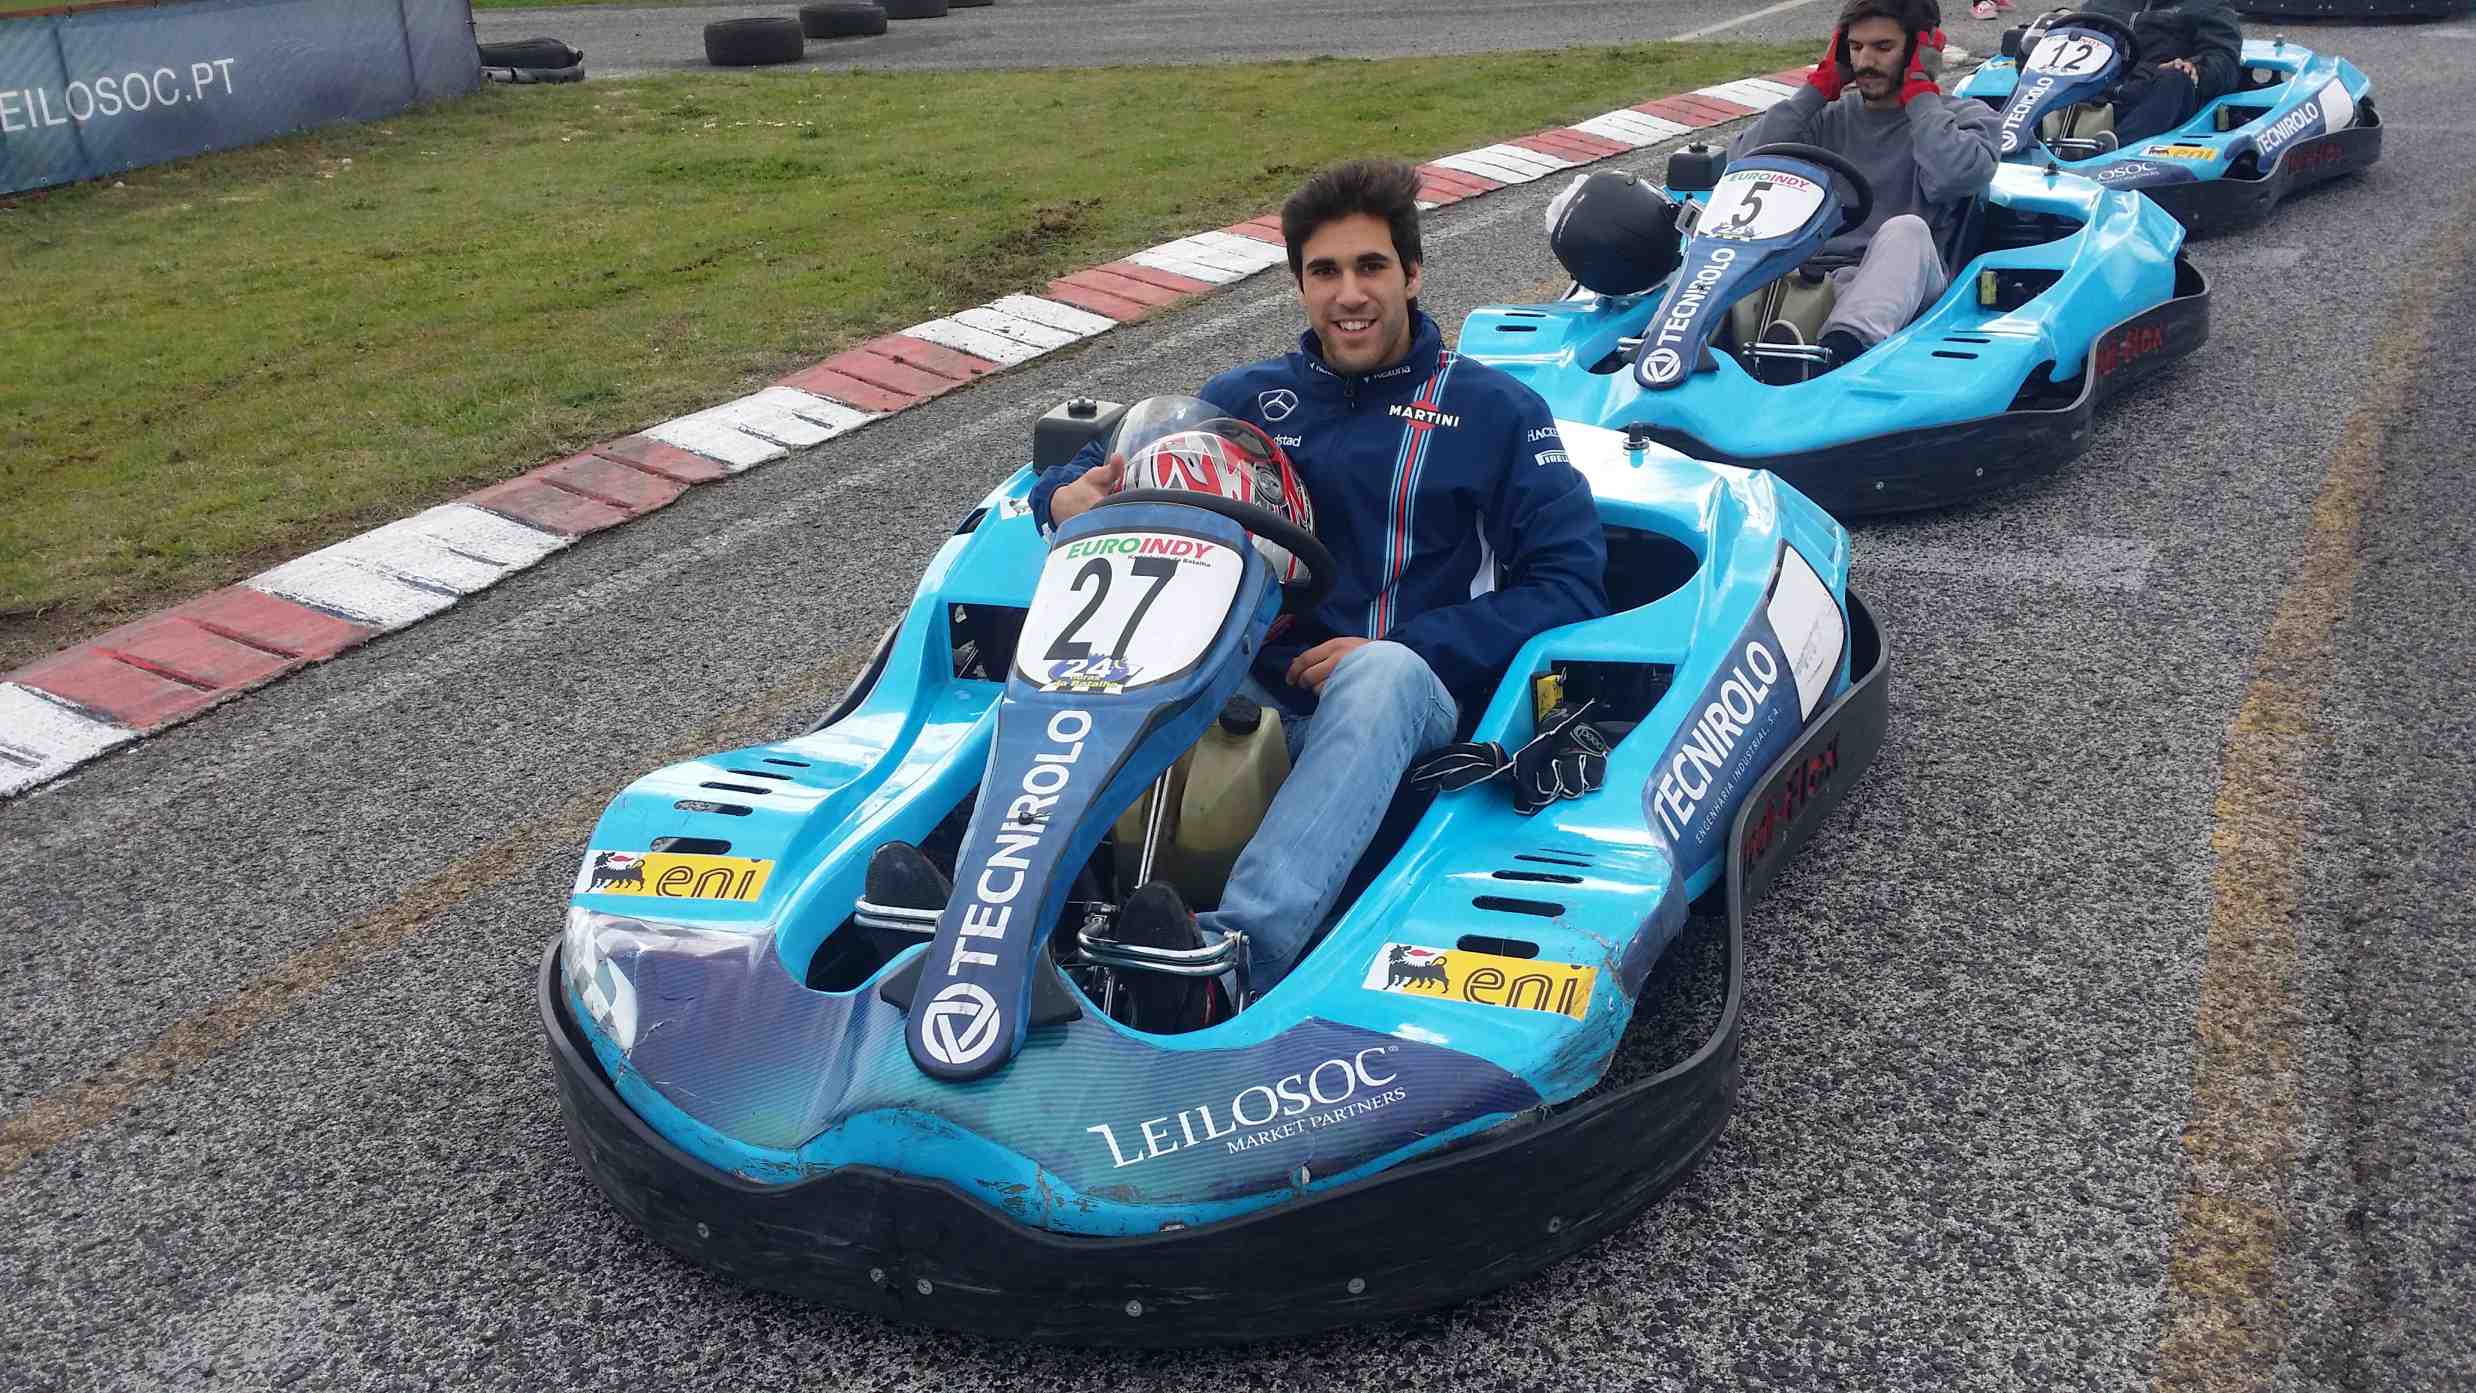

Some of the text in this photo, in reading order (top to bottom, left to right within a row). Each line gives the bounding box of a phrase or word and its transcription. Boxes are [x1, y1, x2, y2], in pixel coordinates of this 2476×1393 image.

[2050, 41, 2093, 70] 12
[2257, 102, 2319, 155] TECNIROLO
[1731, 181, 1774, 227] 5
[1657, 247, 1736, 346] TECNIROLO
[1388, 404, 1460, 428] MARTINI
[1067, 537, 1215, 560] EUROINDY
[1042, 556, 1180, 661] 27
[1654, 641, 1778, 841] TECNIROLO
[946, 709, 1094, 977] TECNIROLO
[656, 858, 762, 900] eni
[1463, 964, 1581, 1017] eni
[1087, 1046, 1398, 1168] LEILOSOC
[1227, 1085, 1407, 1155] MARKET PARTNERS
